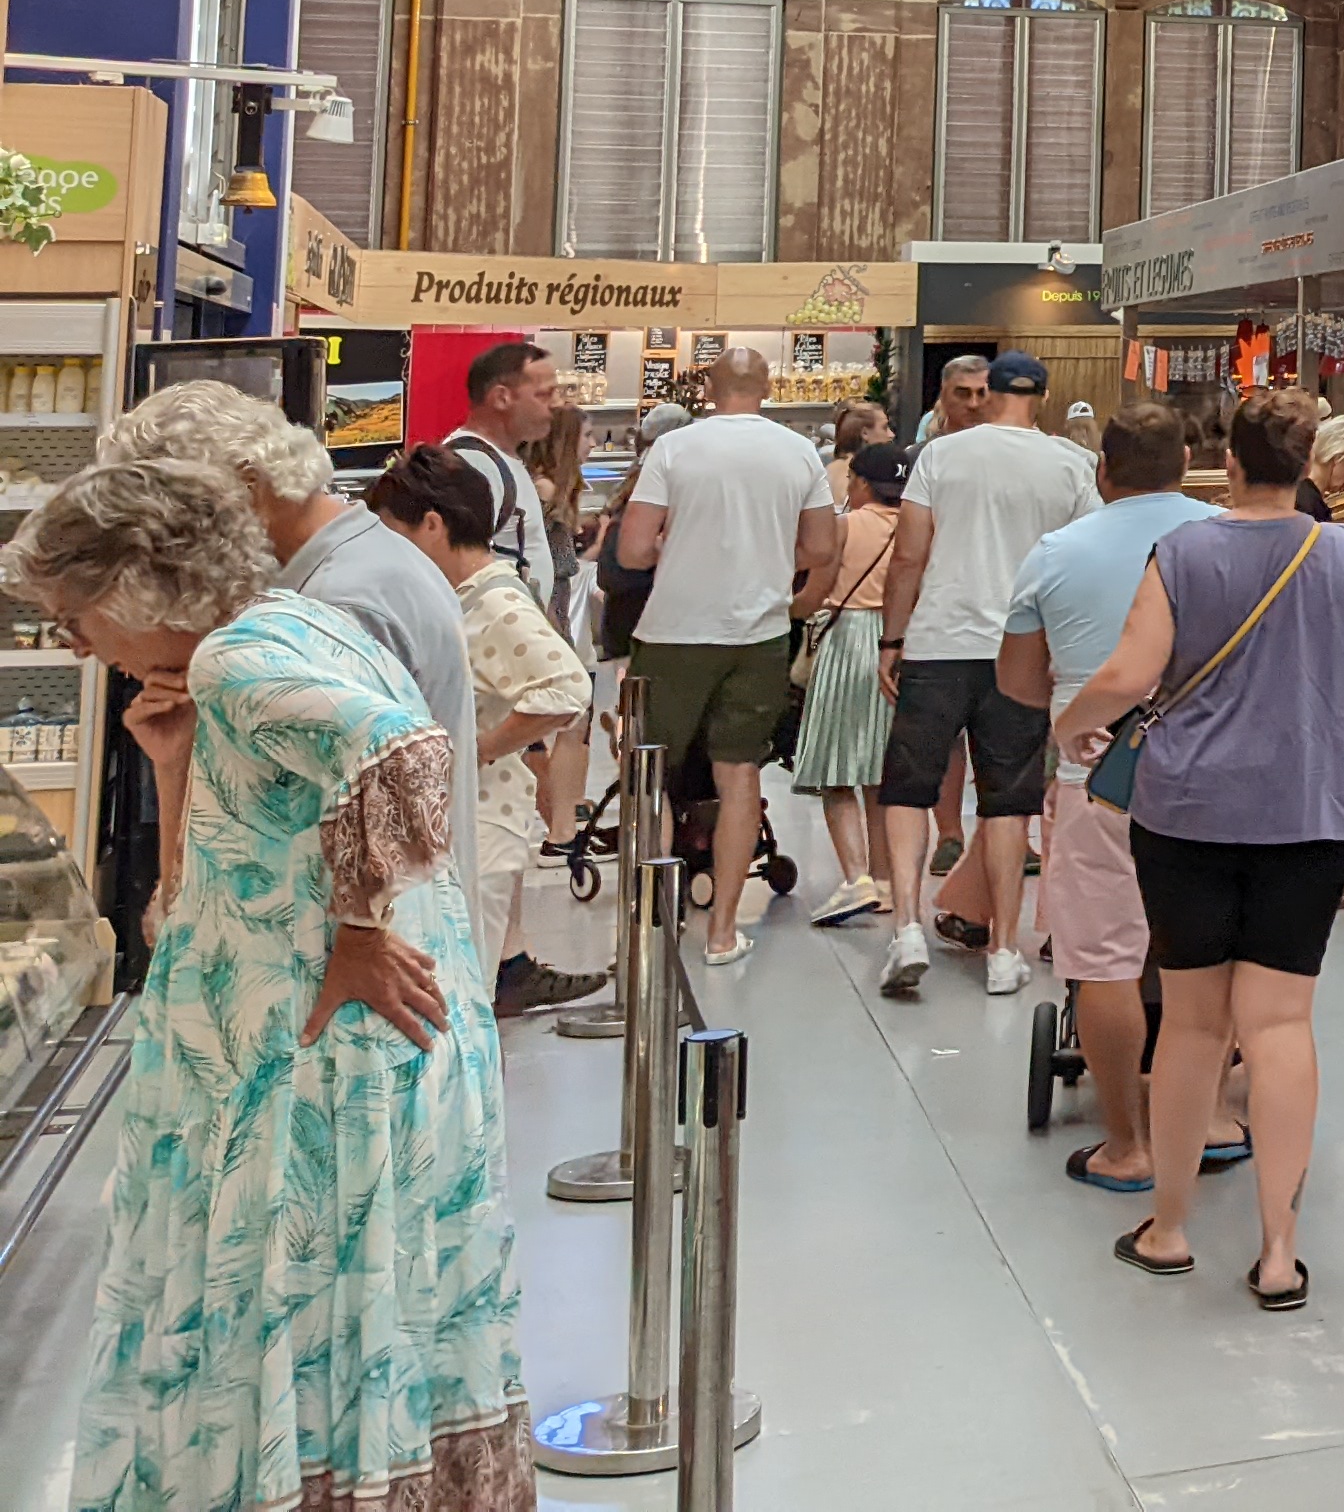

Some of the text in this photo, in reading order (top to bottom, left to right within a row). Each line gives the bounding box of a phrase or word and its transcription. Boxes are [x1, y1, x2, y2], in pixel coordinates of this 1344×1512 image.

[411, 271, 683, 316] Produits régionaux
[1042, 290, 1101, 303] Depuis 19
[1102, 264, 1132, 305] RUITS
